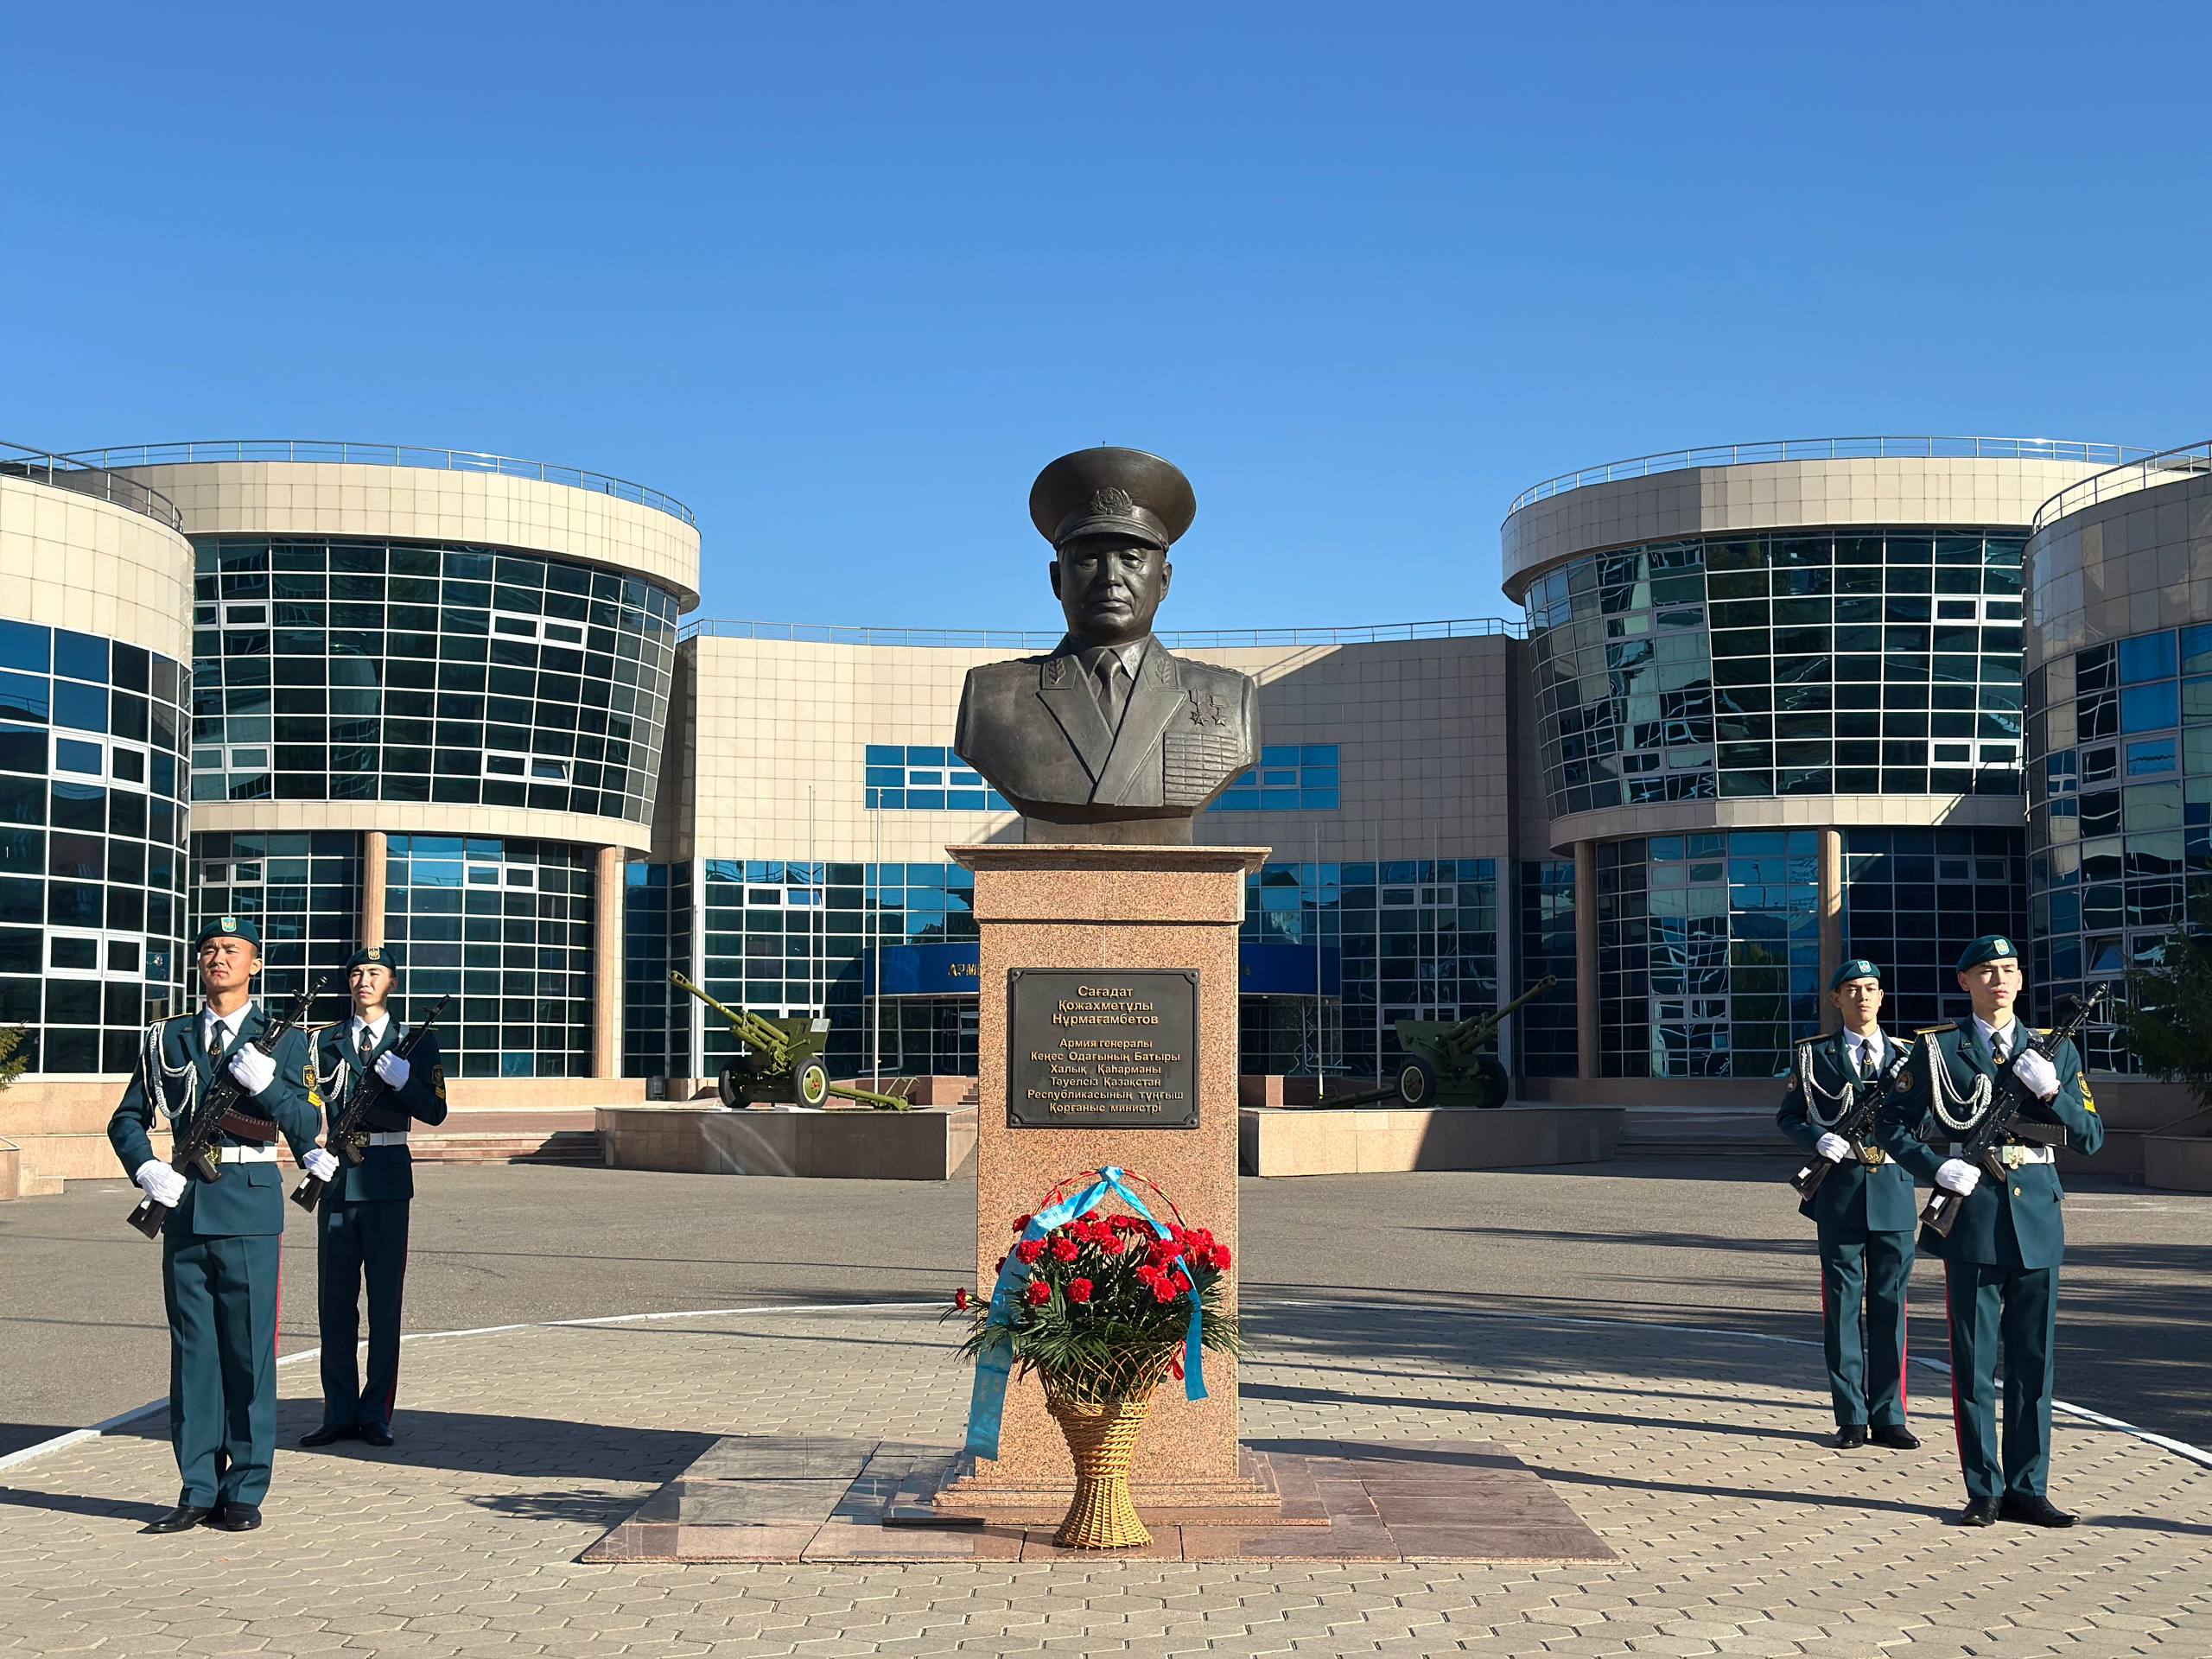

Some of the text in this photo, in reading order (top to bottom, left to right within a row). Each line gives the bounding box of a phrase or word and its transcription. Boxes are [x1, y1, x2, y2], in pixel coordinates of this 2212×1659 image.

[1077, 985, 1134, 999] Сағадат
[1058, 1000, 1154, 1013] Қожахметұлы
[1052, 1014, 1159, 1027] Нұрмағамбетов
[1058, 1038, 1153, 1050] Армия генералы
[1030, 1051, 1180, 1063] Кеңес Одағының Батыры
[1050, 1064, 1161, 1076] Халық Қаһарманы
[1050, 1077, 1161, 1088] Тәуелсіз Қазақстан
[1027, 1089, 1184, 1102] Республикасының тұңғыш
[1049, 1103, 1161, 1115] Қорғаныс министрі
